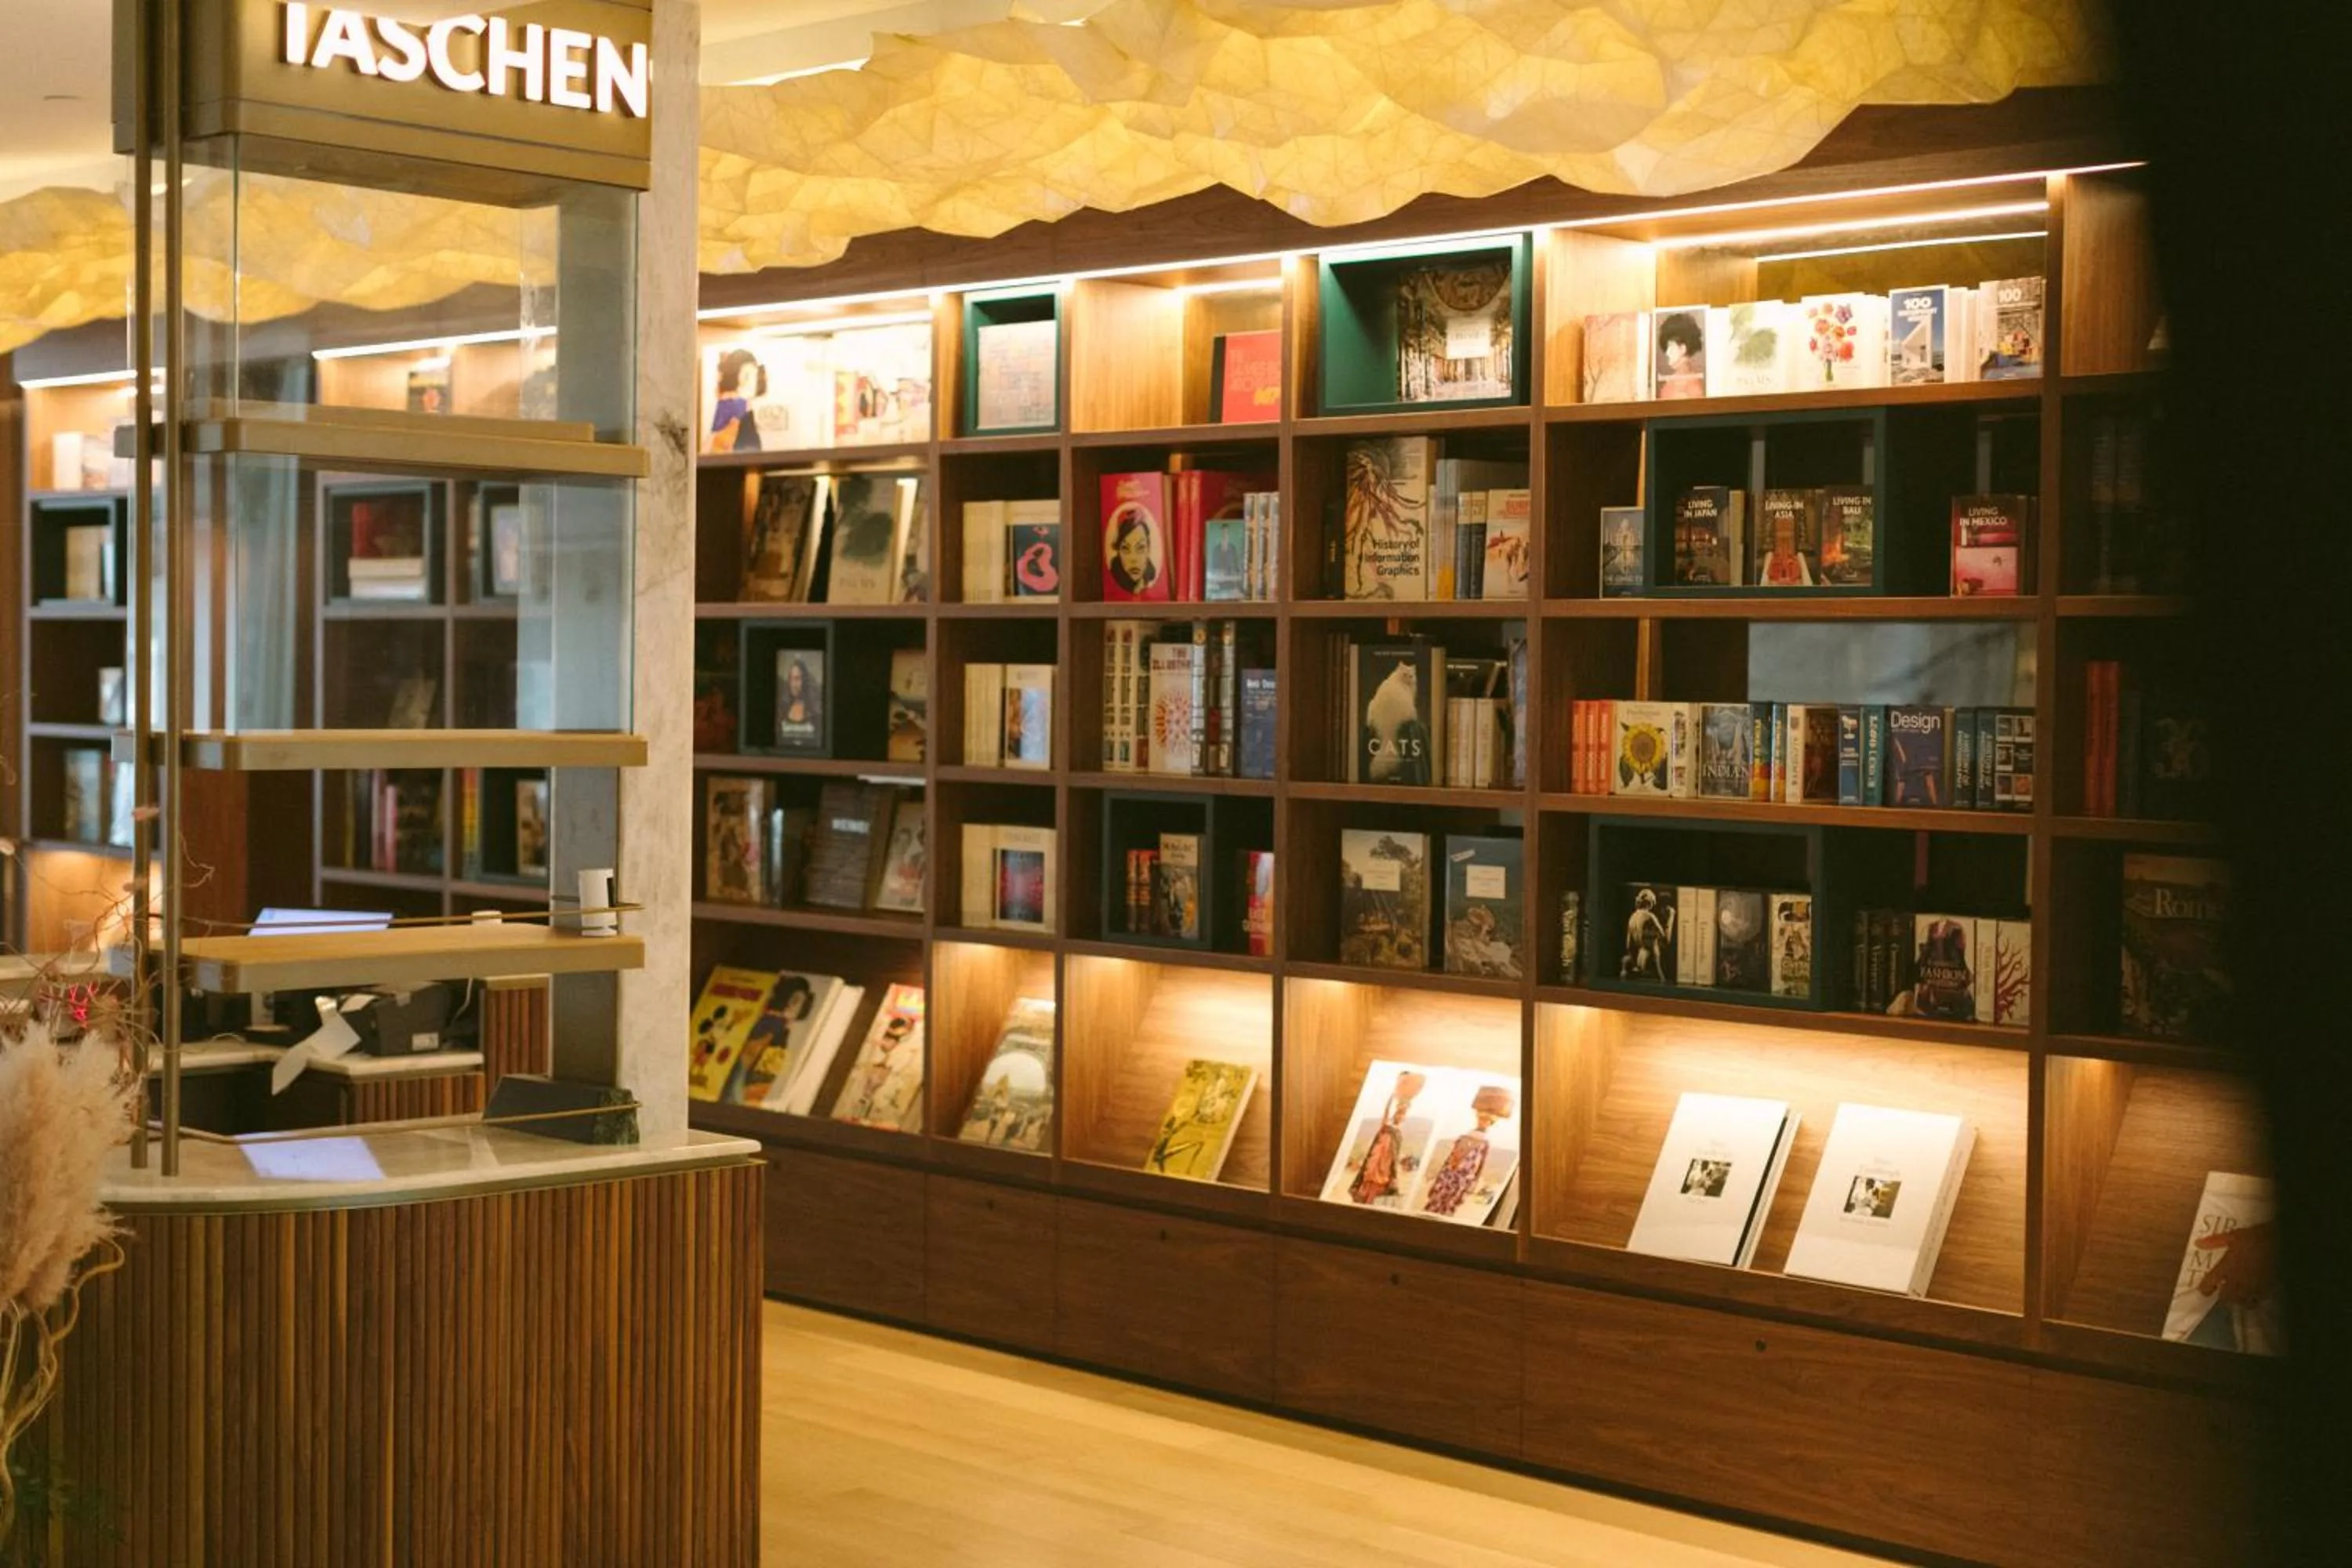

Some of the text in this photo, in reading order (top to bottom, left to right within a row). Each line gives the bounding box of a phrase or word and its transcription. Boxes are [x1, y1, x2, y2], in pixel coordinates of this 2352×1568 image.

[1998, 287, 2022, 303] 100
[1904, 296, 1933, 310] 100
[1687, 499, 1713, 509] LIVING
[1765, 500, 1792, 510] LIVING
[1832, 496, 1860, 506] LIVING
[1694, 508, 1718, 518] JAPAN
[1969, 506, 1998, 516] LIVING
[1971, 517, 2007, 526] MEXICO
[1373, 538, 1408, 550] History
[1364, 551, 1420, 563] Information
[1377, 564, 1420, 577] Graphics
[1890, 710, 1940, 735] Design
[1367, 739, 1421, 757] CATS
[1702, 764, 1749, 779] INDIAN
